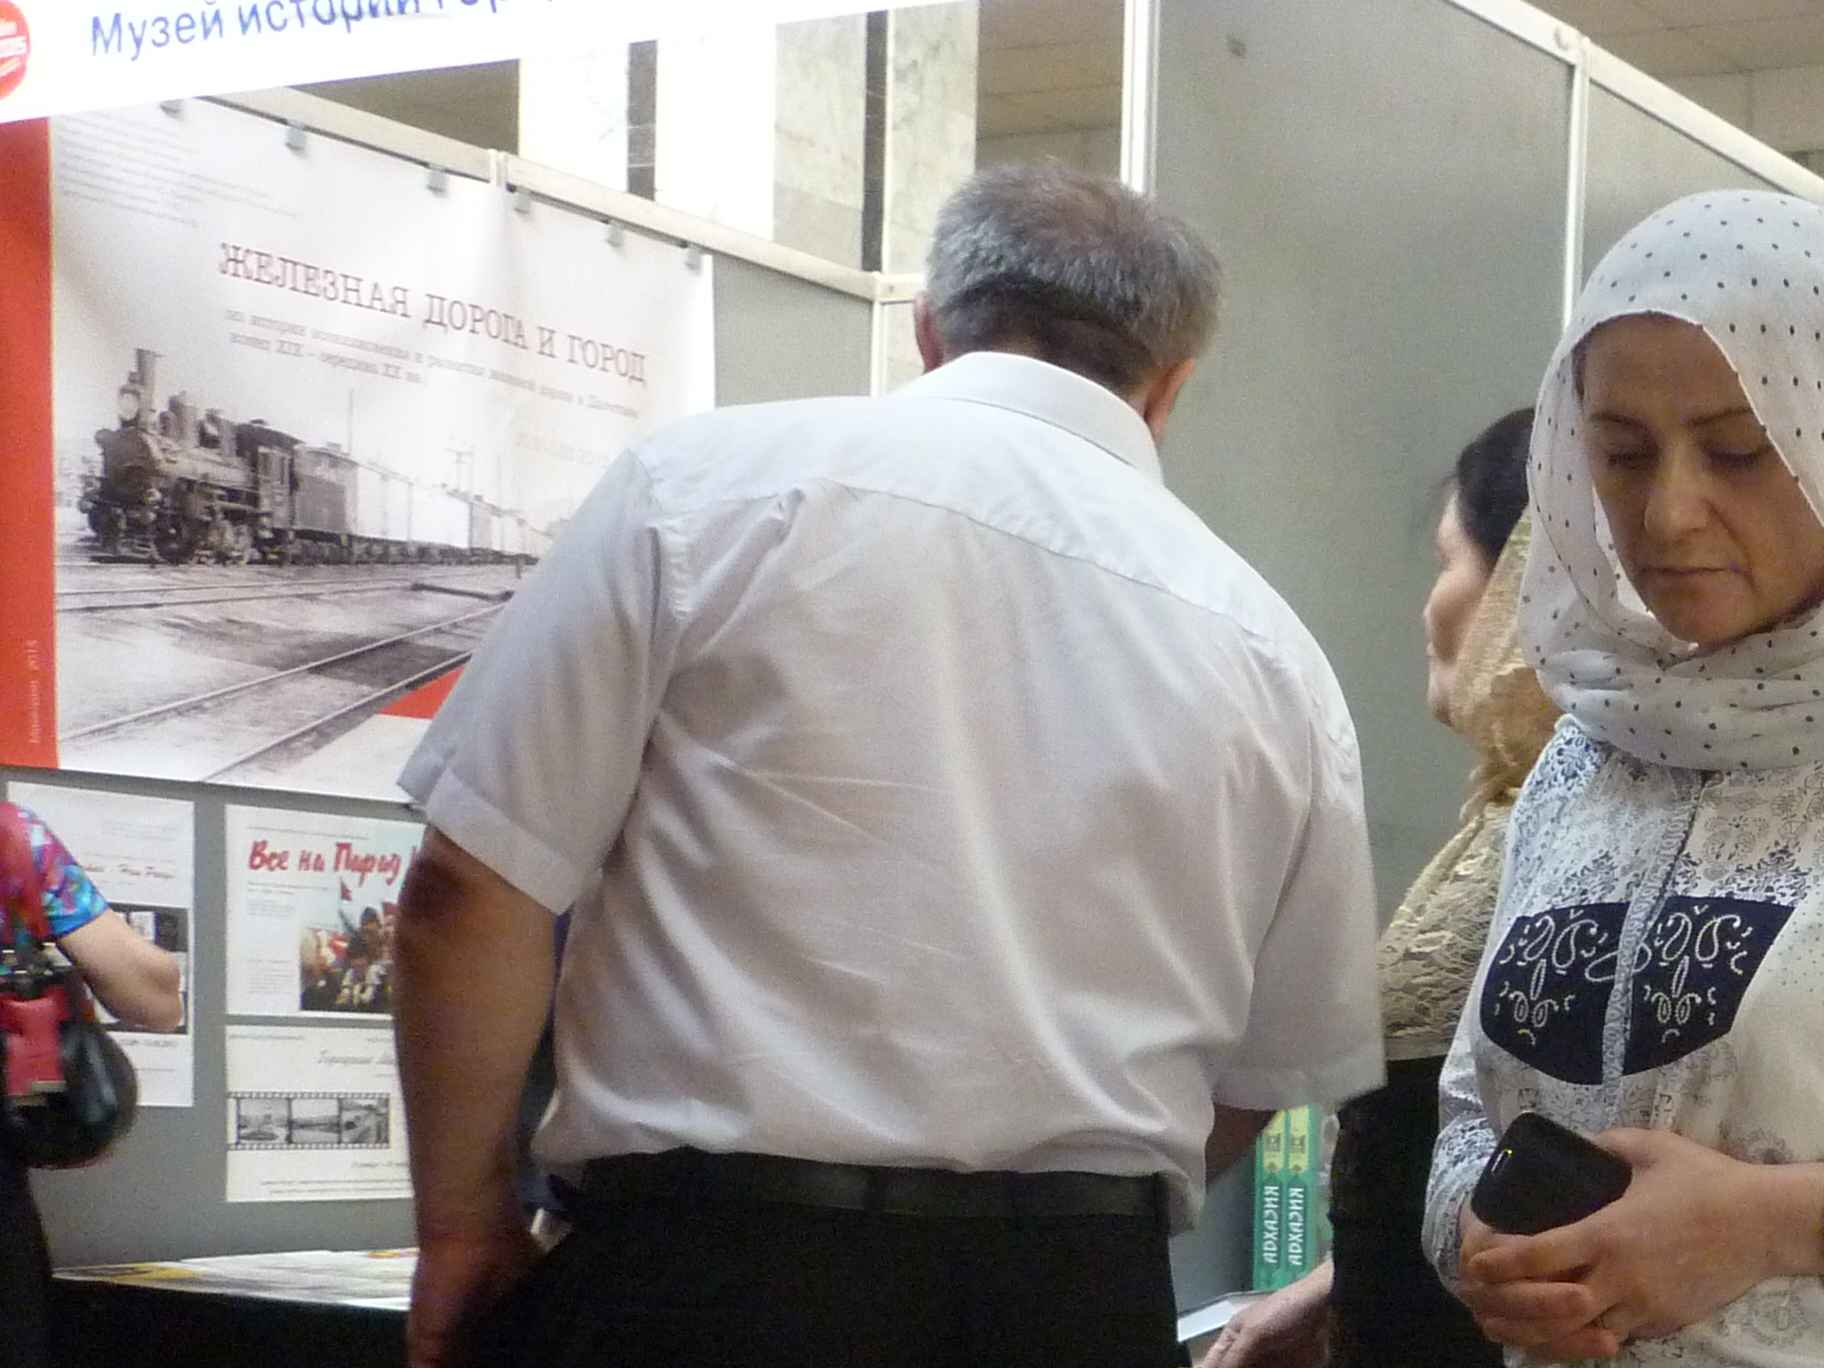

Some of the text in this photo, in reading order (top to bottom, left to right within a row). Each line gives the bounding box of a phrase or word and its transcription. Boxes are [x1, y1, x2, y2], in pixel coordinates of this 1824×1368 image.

[92, 0, 224, 61] Музей
[218, 241, 412, 320] ЖЕЛЕЗНАЯ
[422, 293, 529, 351] ДОРОГА
[536, 326, 557, 360] И
[565, 331, 648, 389] ГОРОД
[248, 839, 290, 872] Все
[298, 850, 326, 873] на
